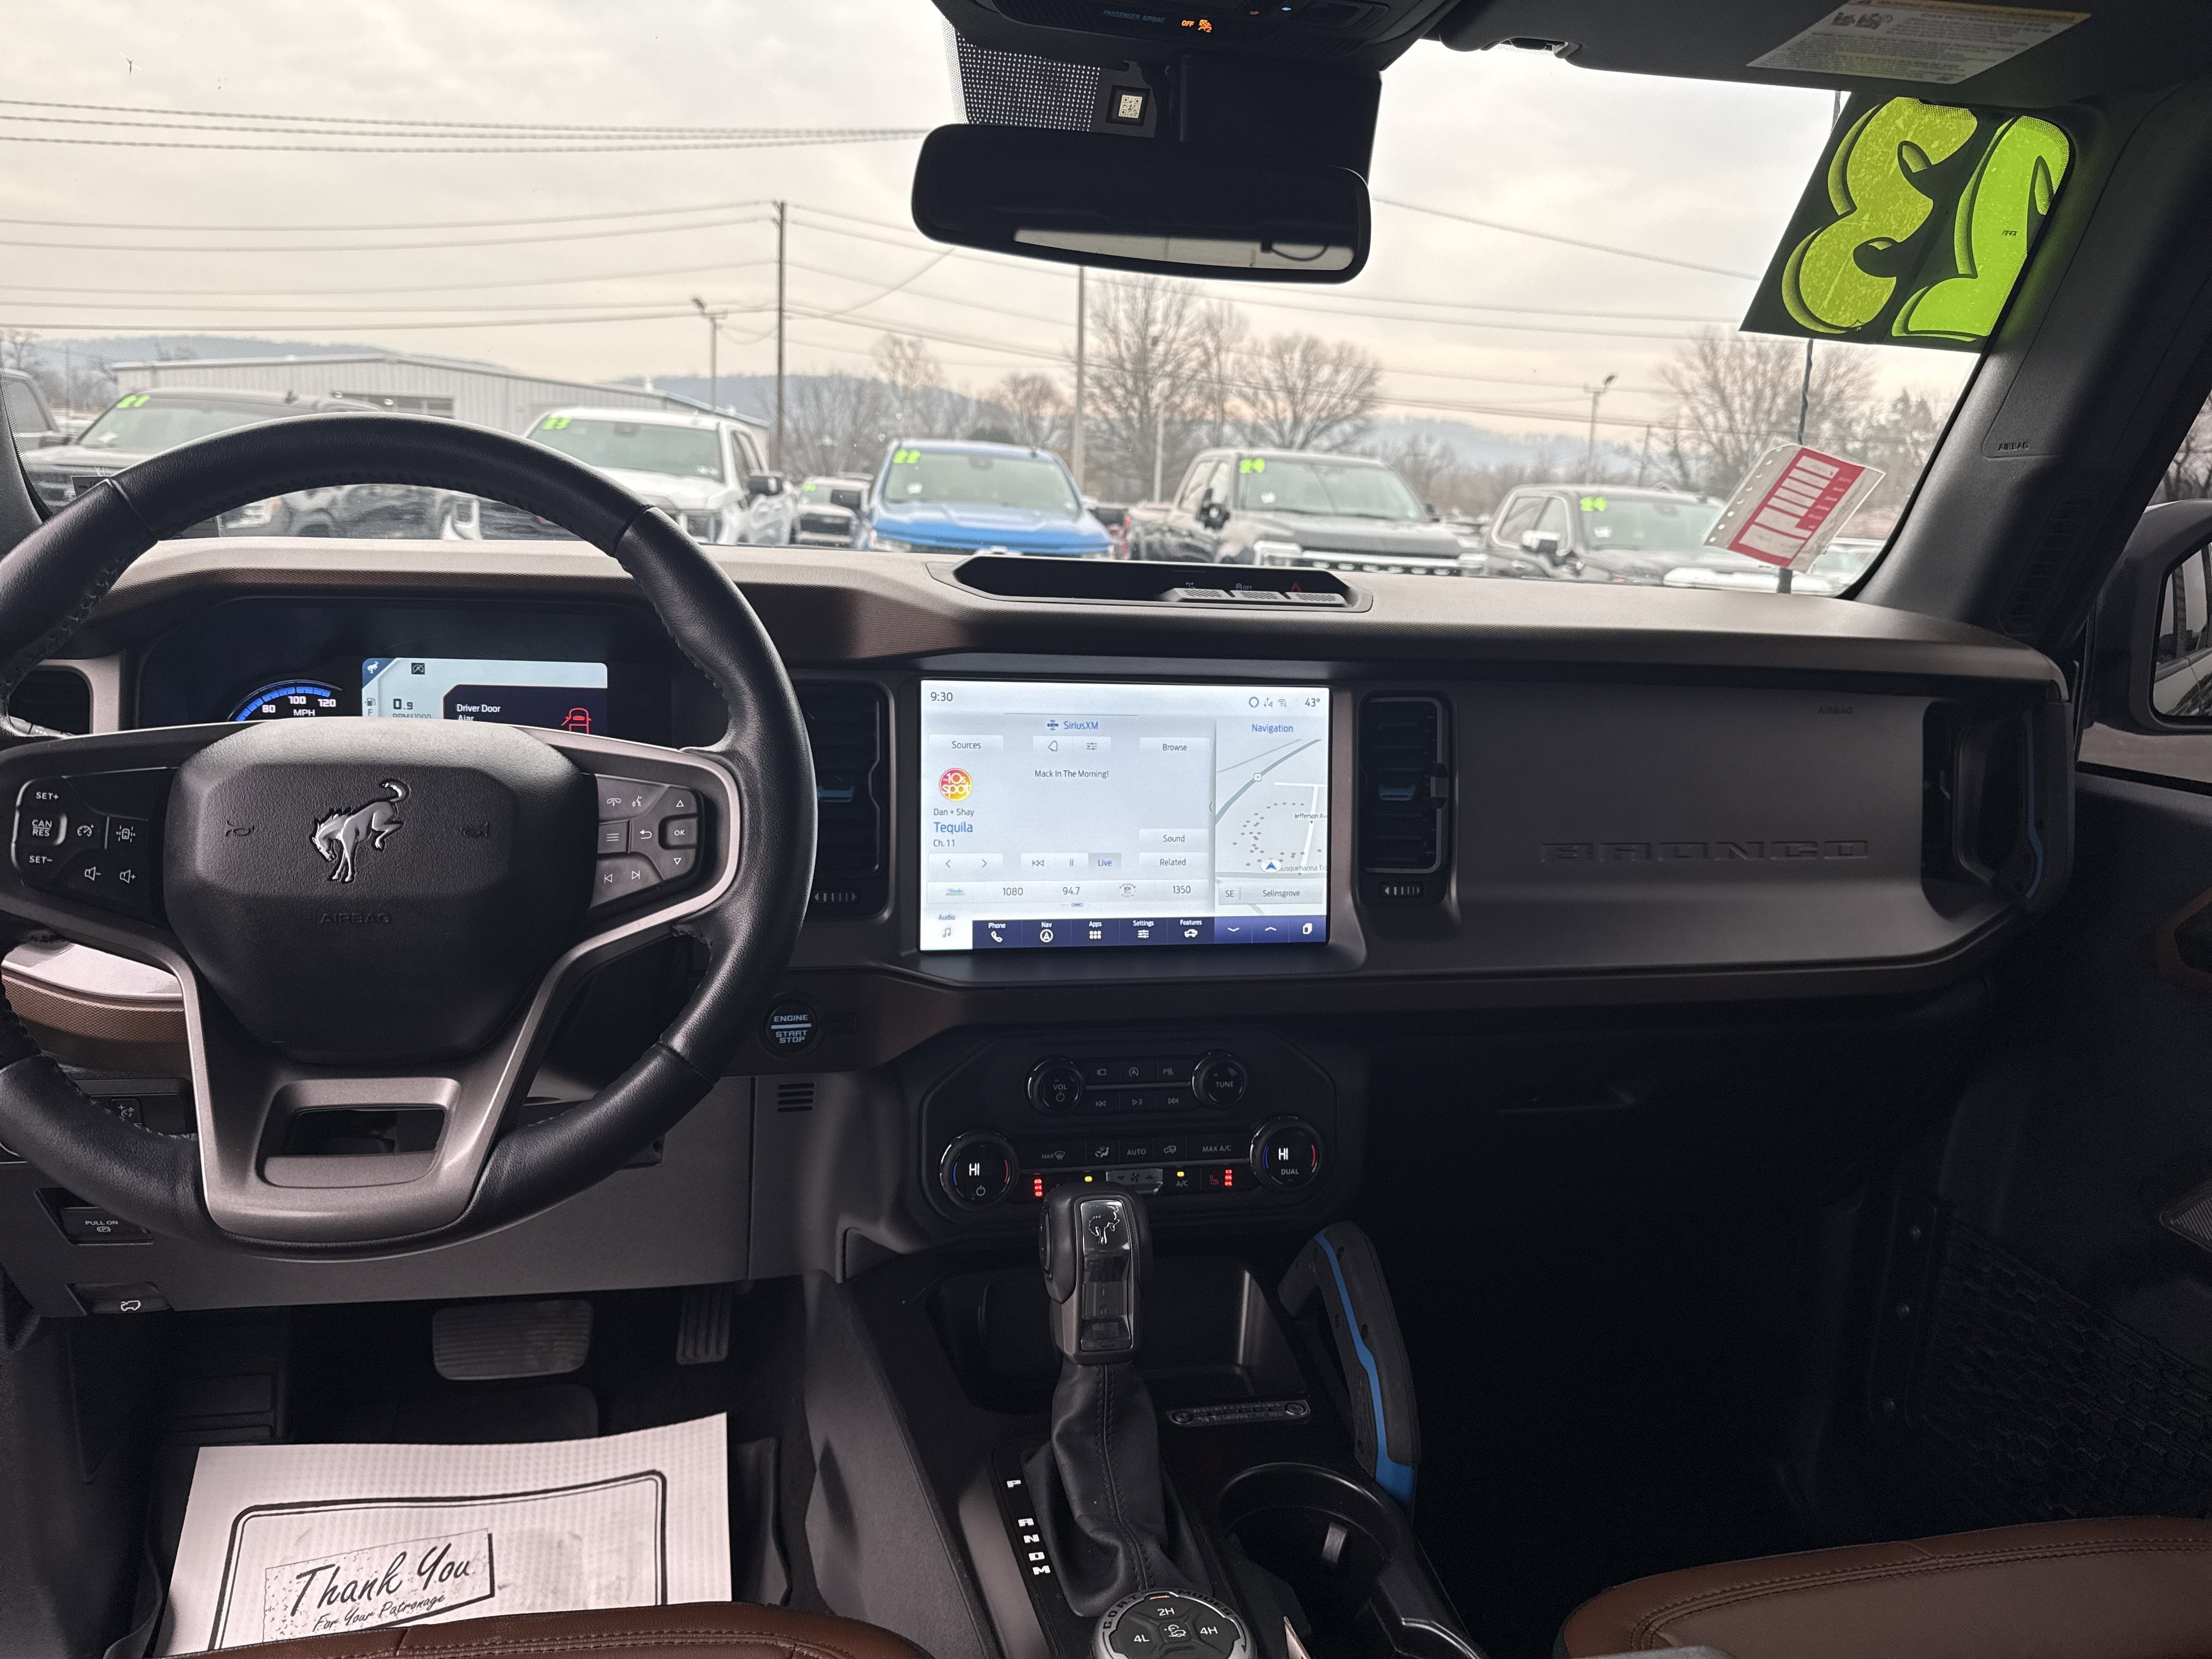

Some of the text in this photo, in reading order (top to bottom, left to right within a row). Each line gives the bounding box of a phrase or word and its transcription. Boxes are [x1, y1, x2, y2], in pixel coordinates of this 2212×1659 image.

[1103, 10, 1165, 24] PASSENGER AIRBAG
[1997, 442, 2029, 452] AIRBAG
[289, 696, 306, 704] 100
[930, 692, 953, 702] 9:30
[318, 698, 336, 707] 120
[262, 704, 276, 713] 80
[456, 703, 500, 713] Driver Door
[1064, 721, 1098, 730] SiriusXM
[1252, 724, 1293, 733] Navigation
[952, 741, 981, 749] Sources
[1077, 770, 1109, 779] Morning!
[942, 782, 971, 798] spot
[36, 792, 59, 800] SET+
[956, 808, 974, 817] Shay
[32, 820, 52, 828] CAN
[933, 822, 973, 834] Tequila
[32, 829, 50, 837] RES
[1541, 840, 1869, 862] BRONCO
[1003, 887, 1023, 895] 1080
[1063, 887, 1080, 895] 94.7
[1173, 885, 1191, 894] 1350
[1262, 890, 1300, 898] Selinsgrove
[320, 913, 389, 923] AIRBAG
[1278, 1147, 1289, 1161] HI
[969, 1163, 980, 1177] HI
[1006, 1480, 1022, 1488] P
[1023, 1534, 1040, 1544] N
[1032, 1565, 1051, 1575] M
[290, 1543, 471, 1617] Thank You
[1178, 1589, 1233, 1616] MODES
[312, 1595, 445, 1633] For Your Patronage
[1157, 1607, 1175, 1616] 2H
[1200, 1626, 1218, 1635] 4H
[1133, 1634, 1150, 1643] 4L
